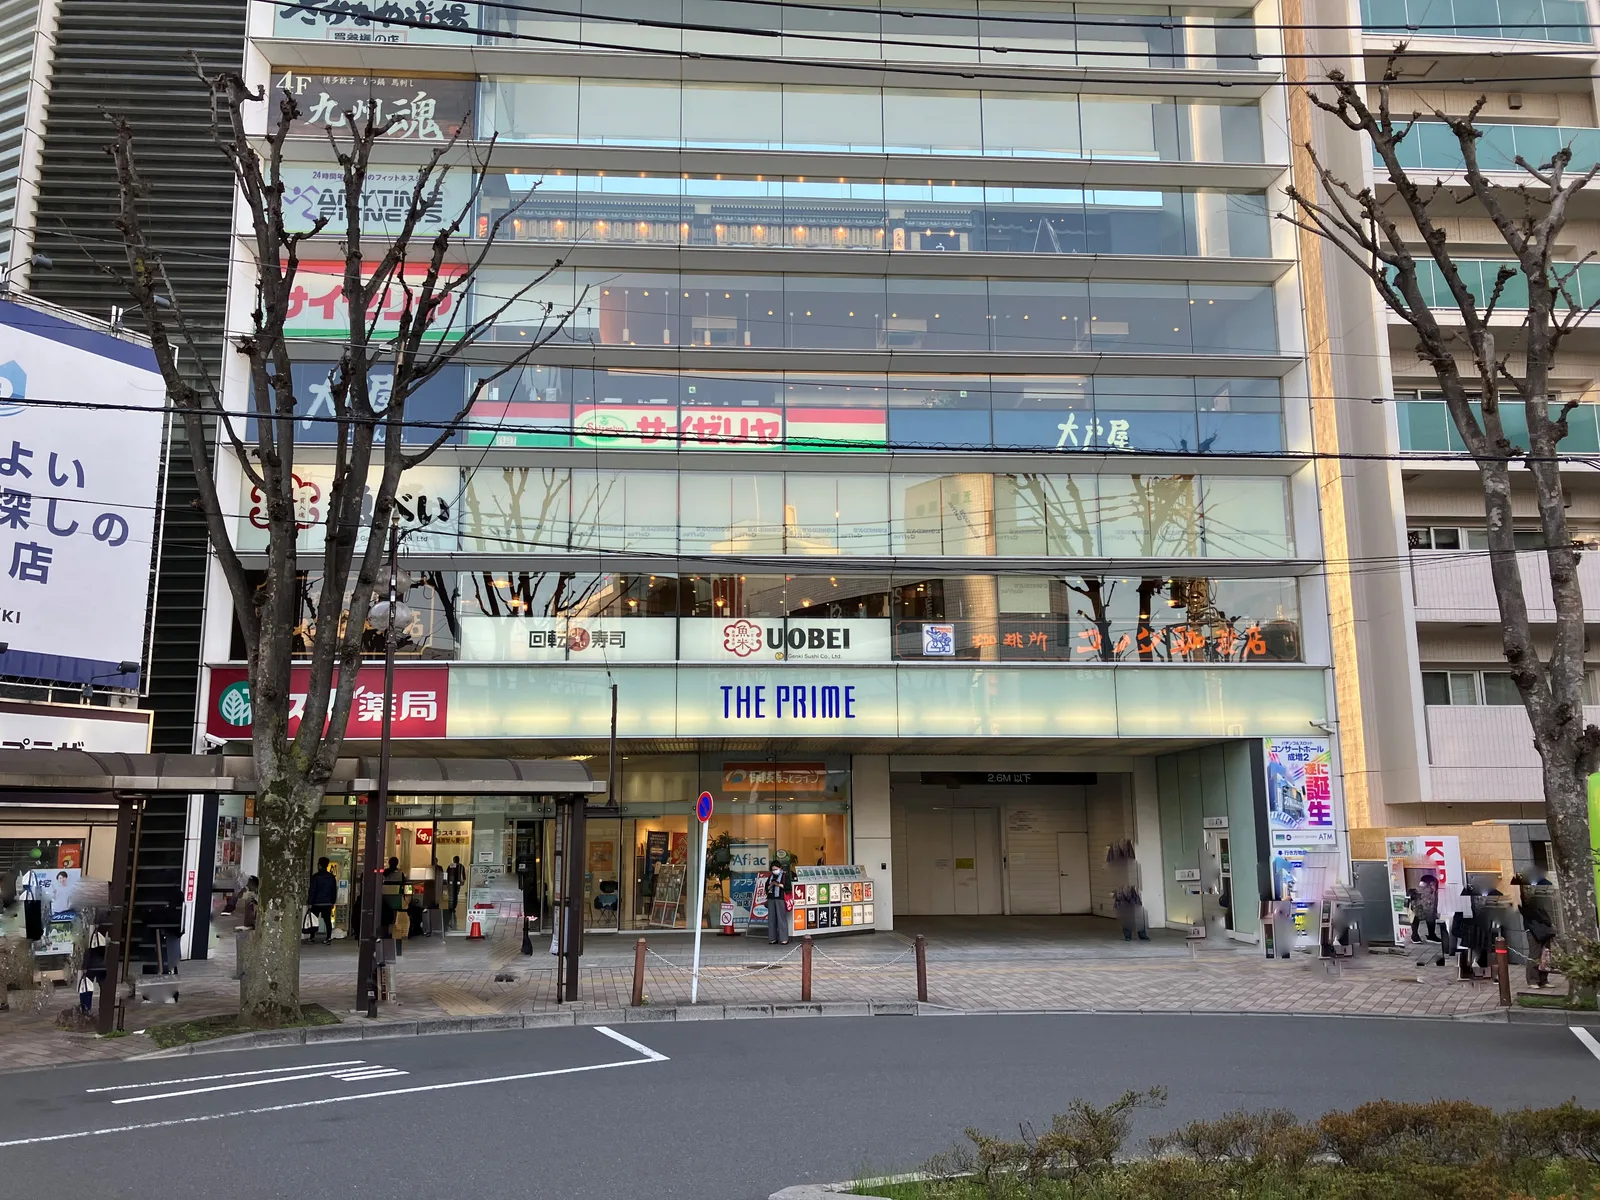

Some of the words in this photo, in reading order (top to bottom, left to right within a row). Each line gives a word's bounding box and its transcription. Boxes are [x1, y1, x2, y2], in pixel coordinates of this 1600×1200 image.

[276, 70, 312, 95] 4F
[303, 91, 445, 139] 九州魂
[636, 415, 781, 447] サイゼリヤ
[1056, 412, 1136, 452] 大戸屋
[766, 627, 850, 650] UOBEI
[720, 685, 766, 718] THE
[776, 685, 856, 719] PRIME
[1271, 745, 1324, 753] コンサートホール
[1288, 753, 1310, 761] 成増2
[987, 773, 1011, 783] 2.6M
[1013, 773, 1031, 783] 以下
[1305, 776, 1333, 826] 誕生
